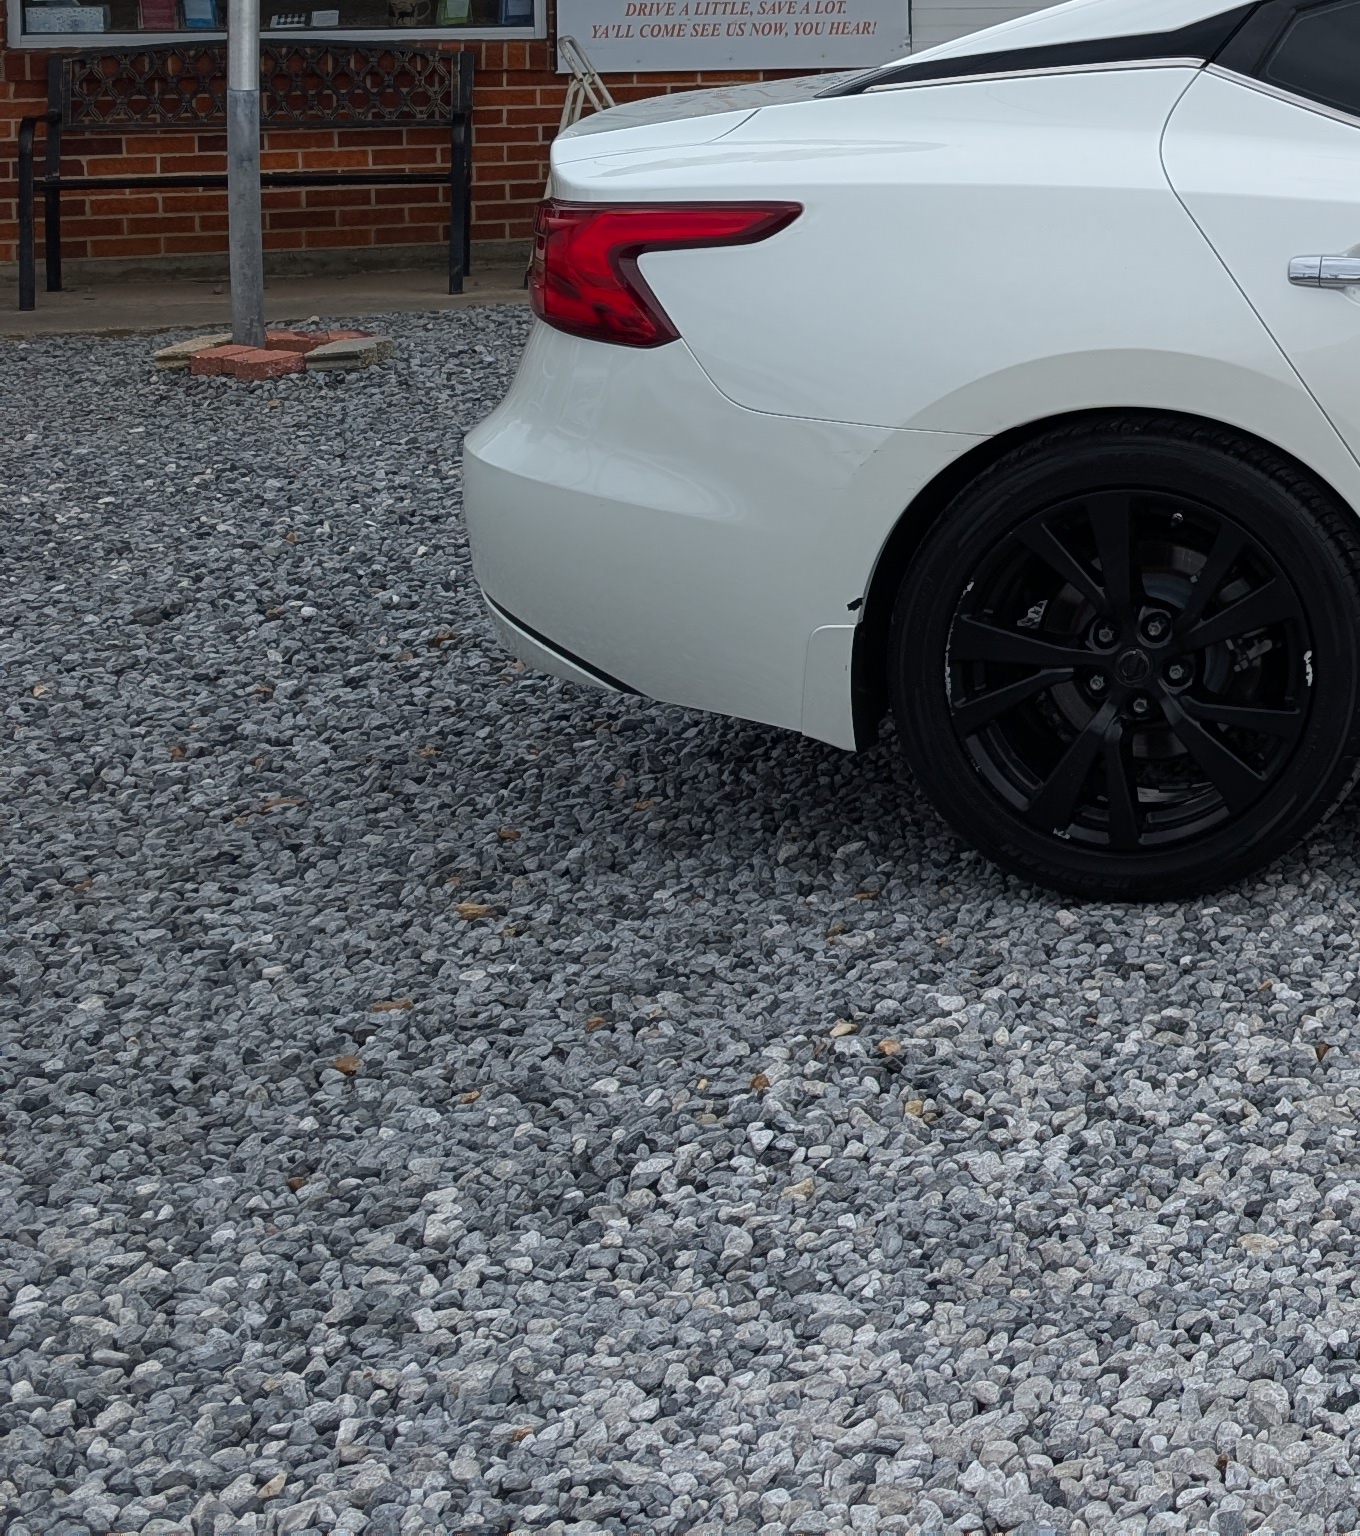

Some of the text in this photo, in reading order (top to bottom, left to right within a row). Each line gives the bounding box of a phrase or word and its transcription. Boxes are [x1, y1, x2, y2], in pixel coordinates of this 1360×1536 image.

[625, 0, 847, 17] DRIVE A LITTLE, SAVE A LOT.
[592, 21, 877, 39] YA'LL COME SEE US NOW, YOU HEAR!
